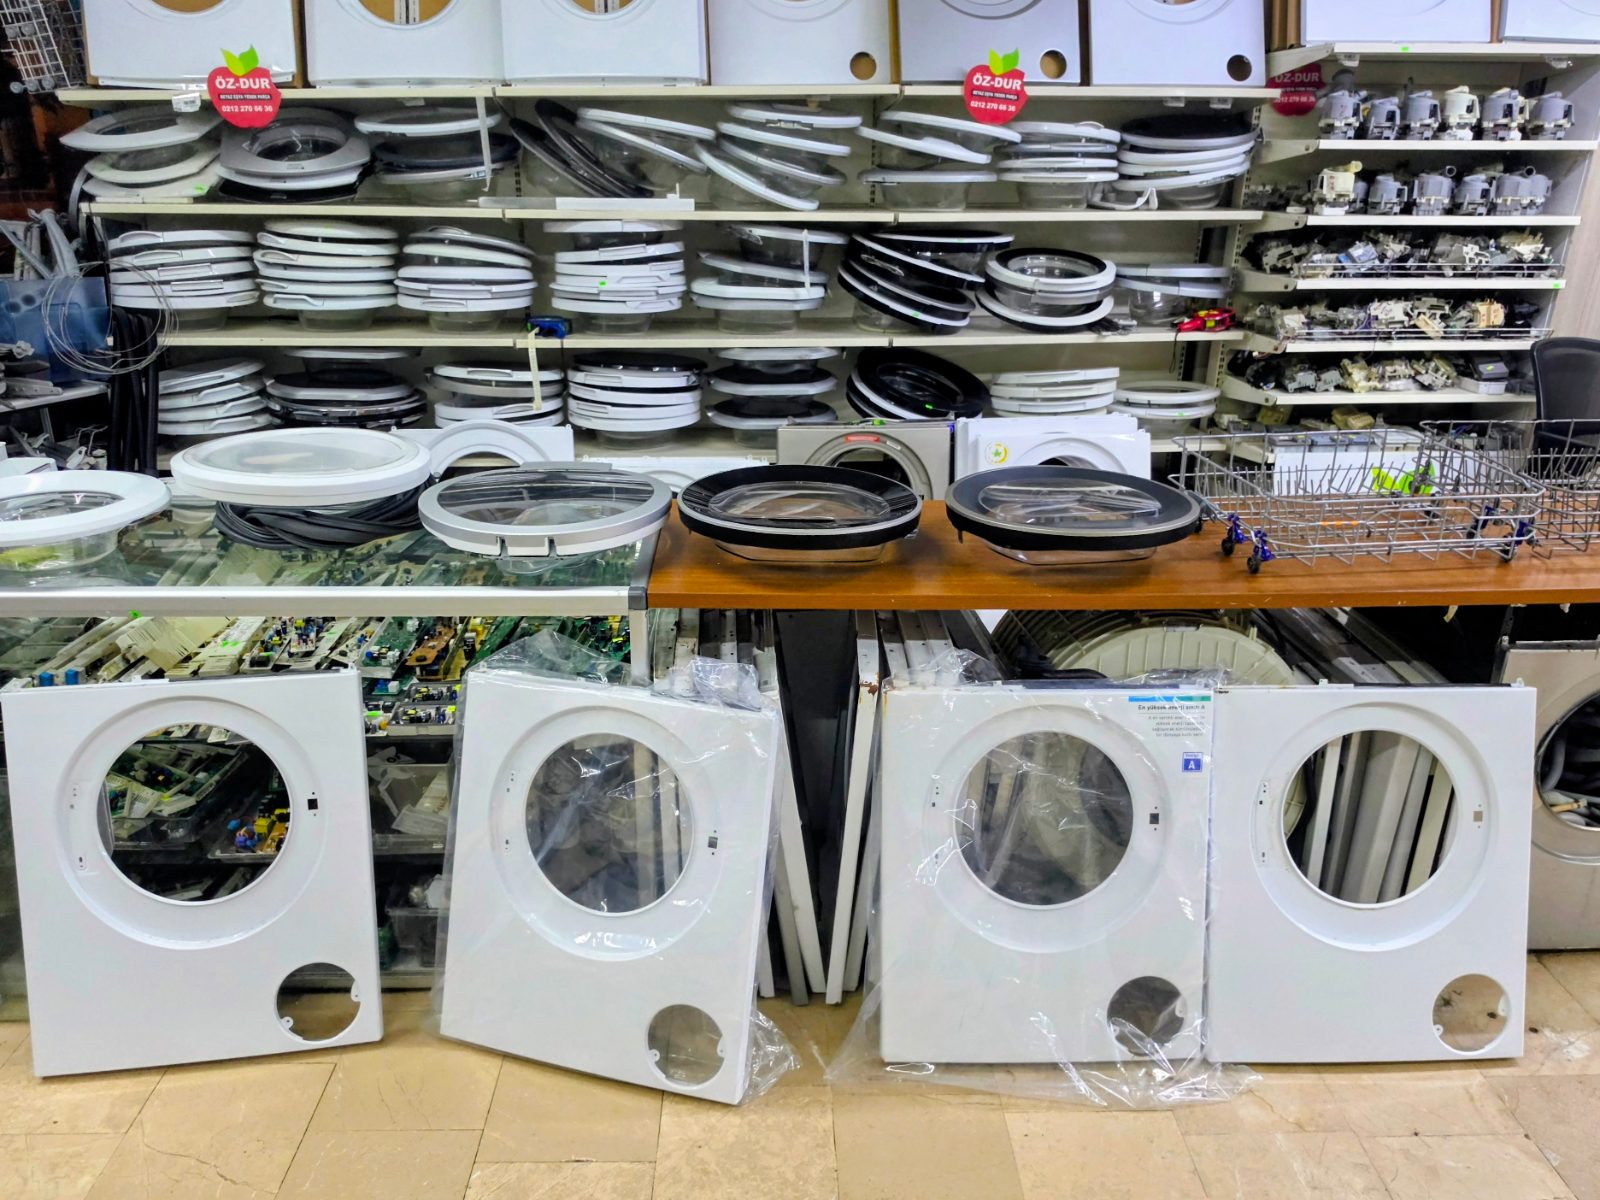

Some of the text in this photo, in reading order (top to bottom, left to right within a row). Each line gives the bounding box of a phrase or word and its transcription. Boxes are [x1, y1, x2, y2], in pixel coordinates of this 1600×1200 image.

[215, 76, 271, 89] ÖZ-DUR
[973, 73, 1022, 90] ÖZ-DUR
[970, 101, 986, 109] 0212
[1188, 760, 1195, 769] A
